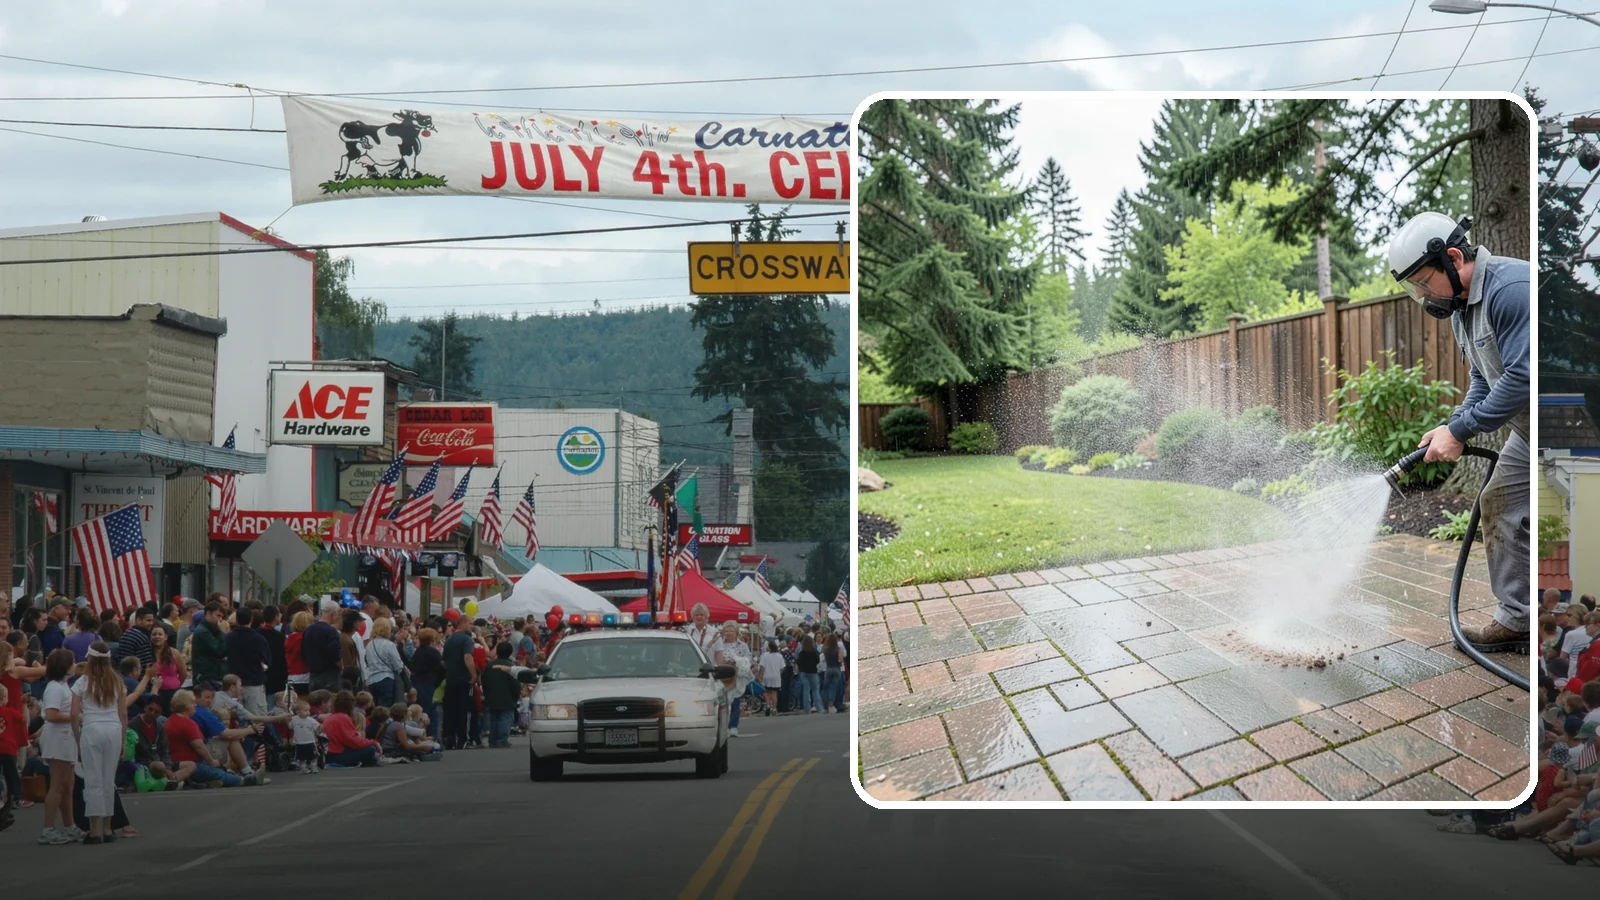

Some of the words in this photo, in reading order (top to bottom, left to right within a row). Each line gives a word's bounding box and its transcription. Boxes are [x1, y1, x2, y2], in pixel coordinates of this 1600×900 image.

[481, 141, 605, 192] JULY
[632, 149, 746, 198] 4th.
[697, 254, 850, 279] CROSSWA
[282, 380, 373, 420] ACE
[406, 409, 453, 421] CEDAR
[283, 421, 371, 436] Hardware
[353, 467, 384, 480] Simpl
[95, 485, 124, 494] Vincent
[126, 486, 136, 494] de
[138, 486, 155, 495] Paul
[688, 526, 741, 535] CRNATION
[699, 535, 730, 543] GLASS
